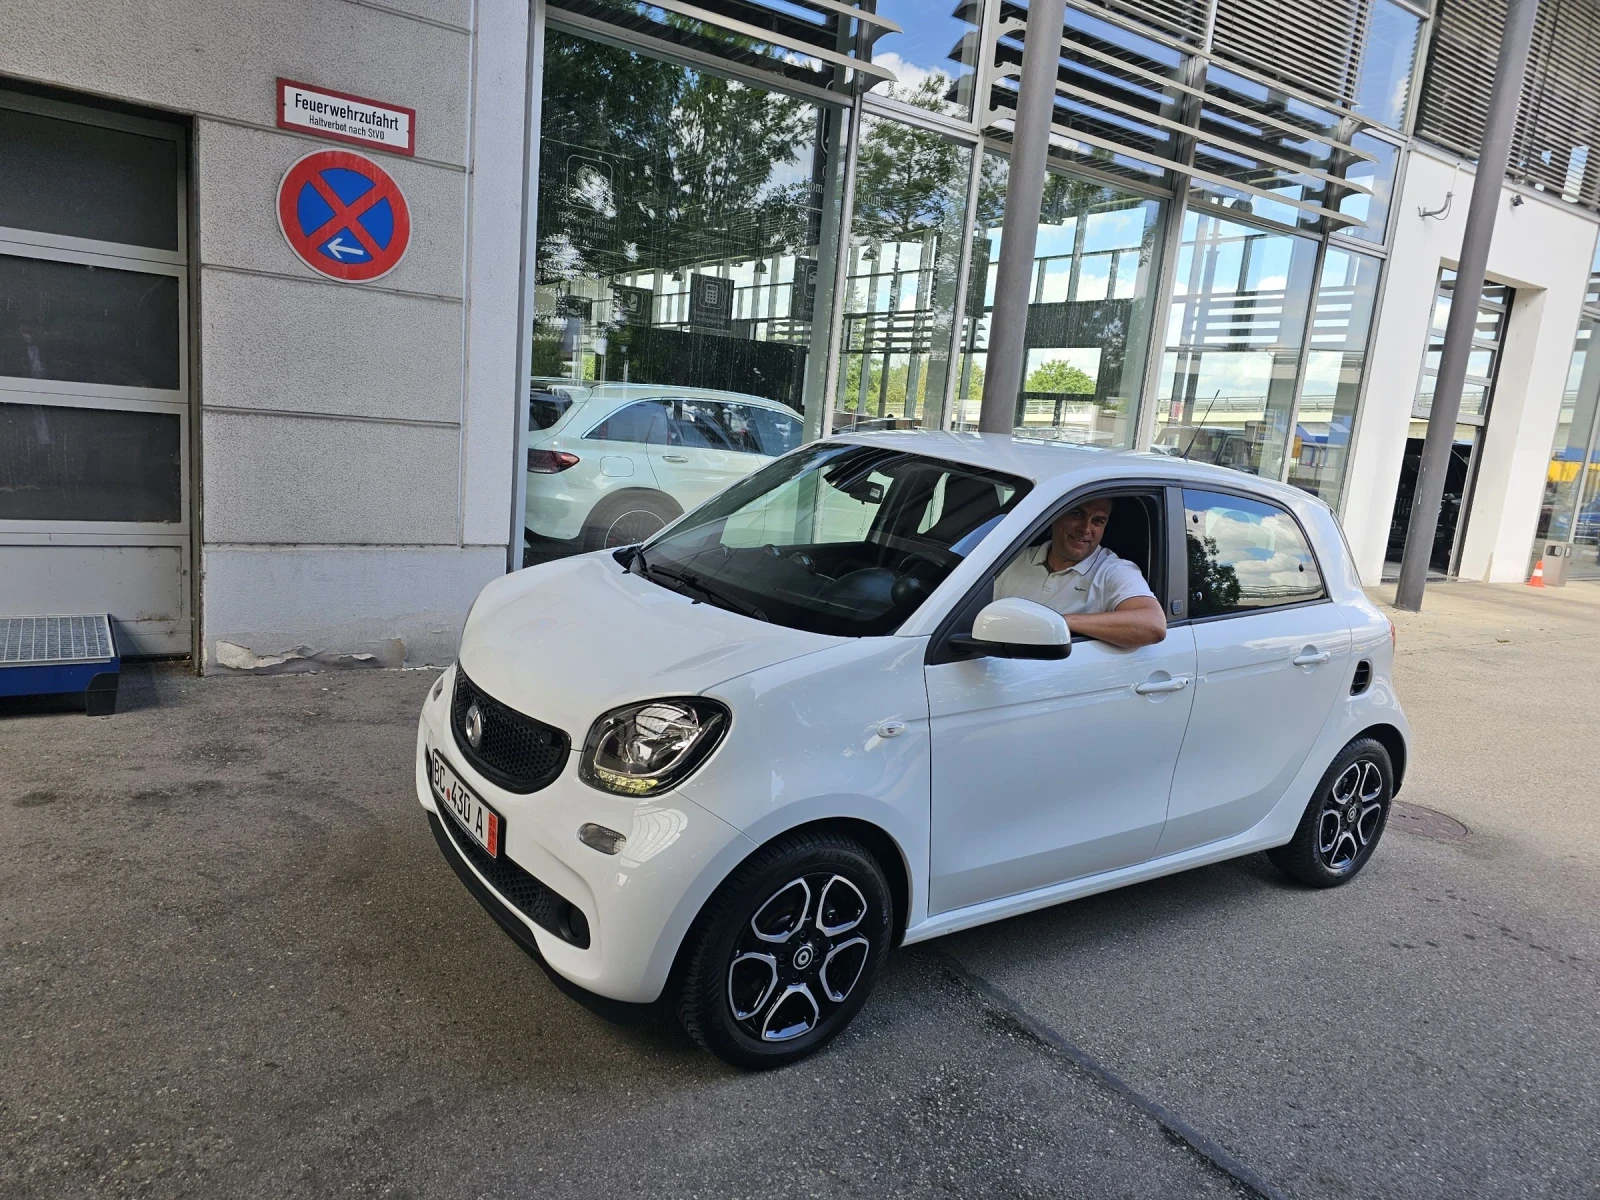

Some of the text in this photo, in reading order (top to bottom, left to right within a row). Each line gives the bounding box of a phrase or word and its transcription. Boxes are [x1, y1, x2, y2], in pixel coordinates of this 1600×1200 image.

[295, 92, 399, 131] Feuerwehrzufahrt
[309, 114, 385, 140] Haltverbot nach StVO
[435, 757, 483, 839] BC 430 A
